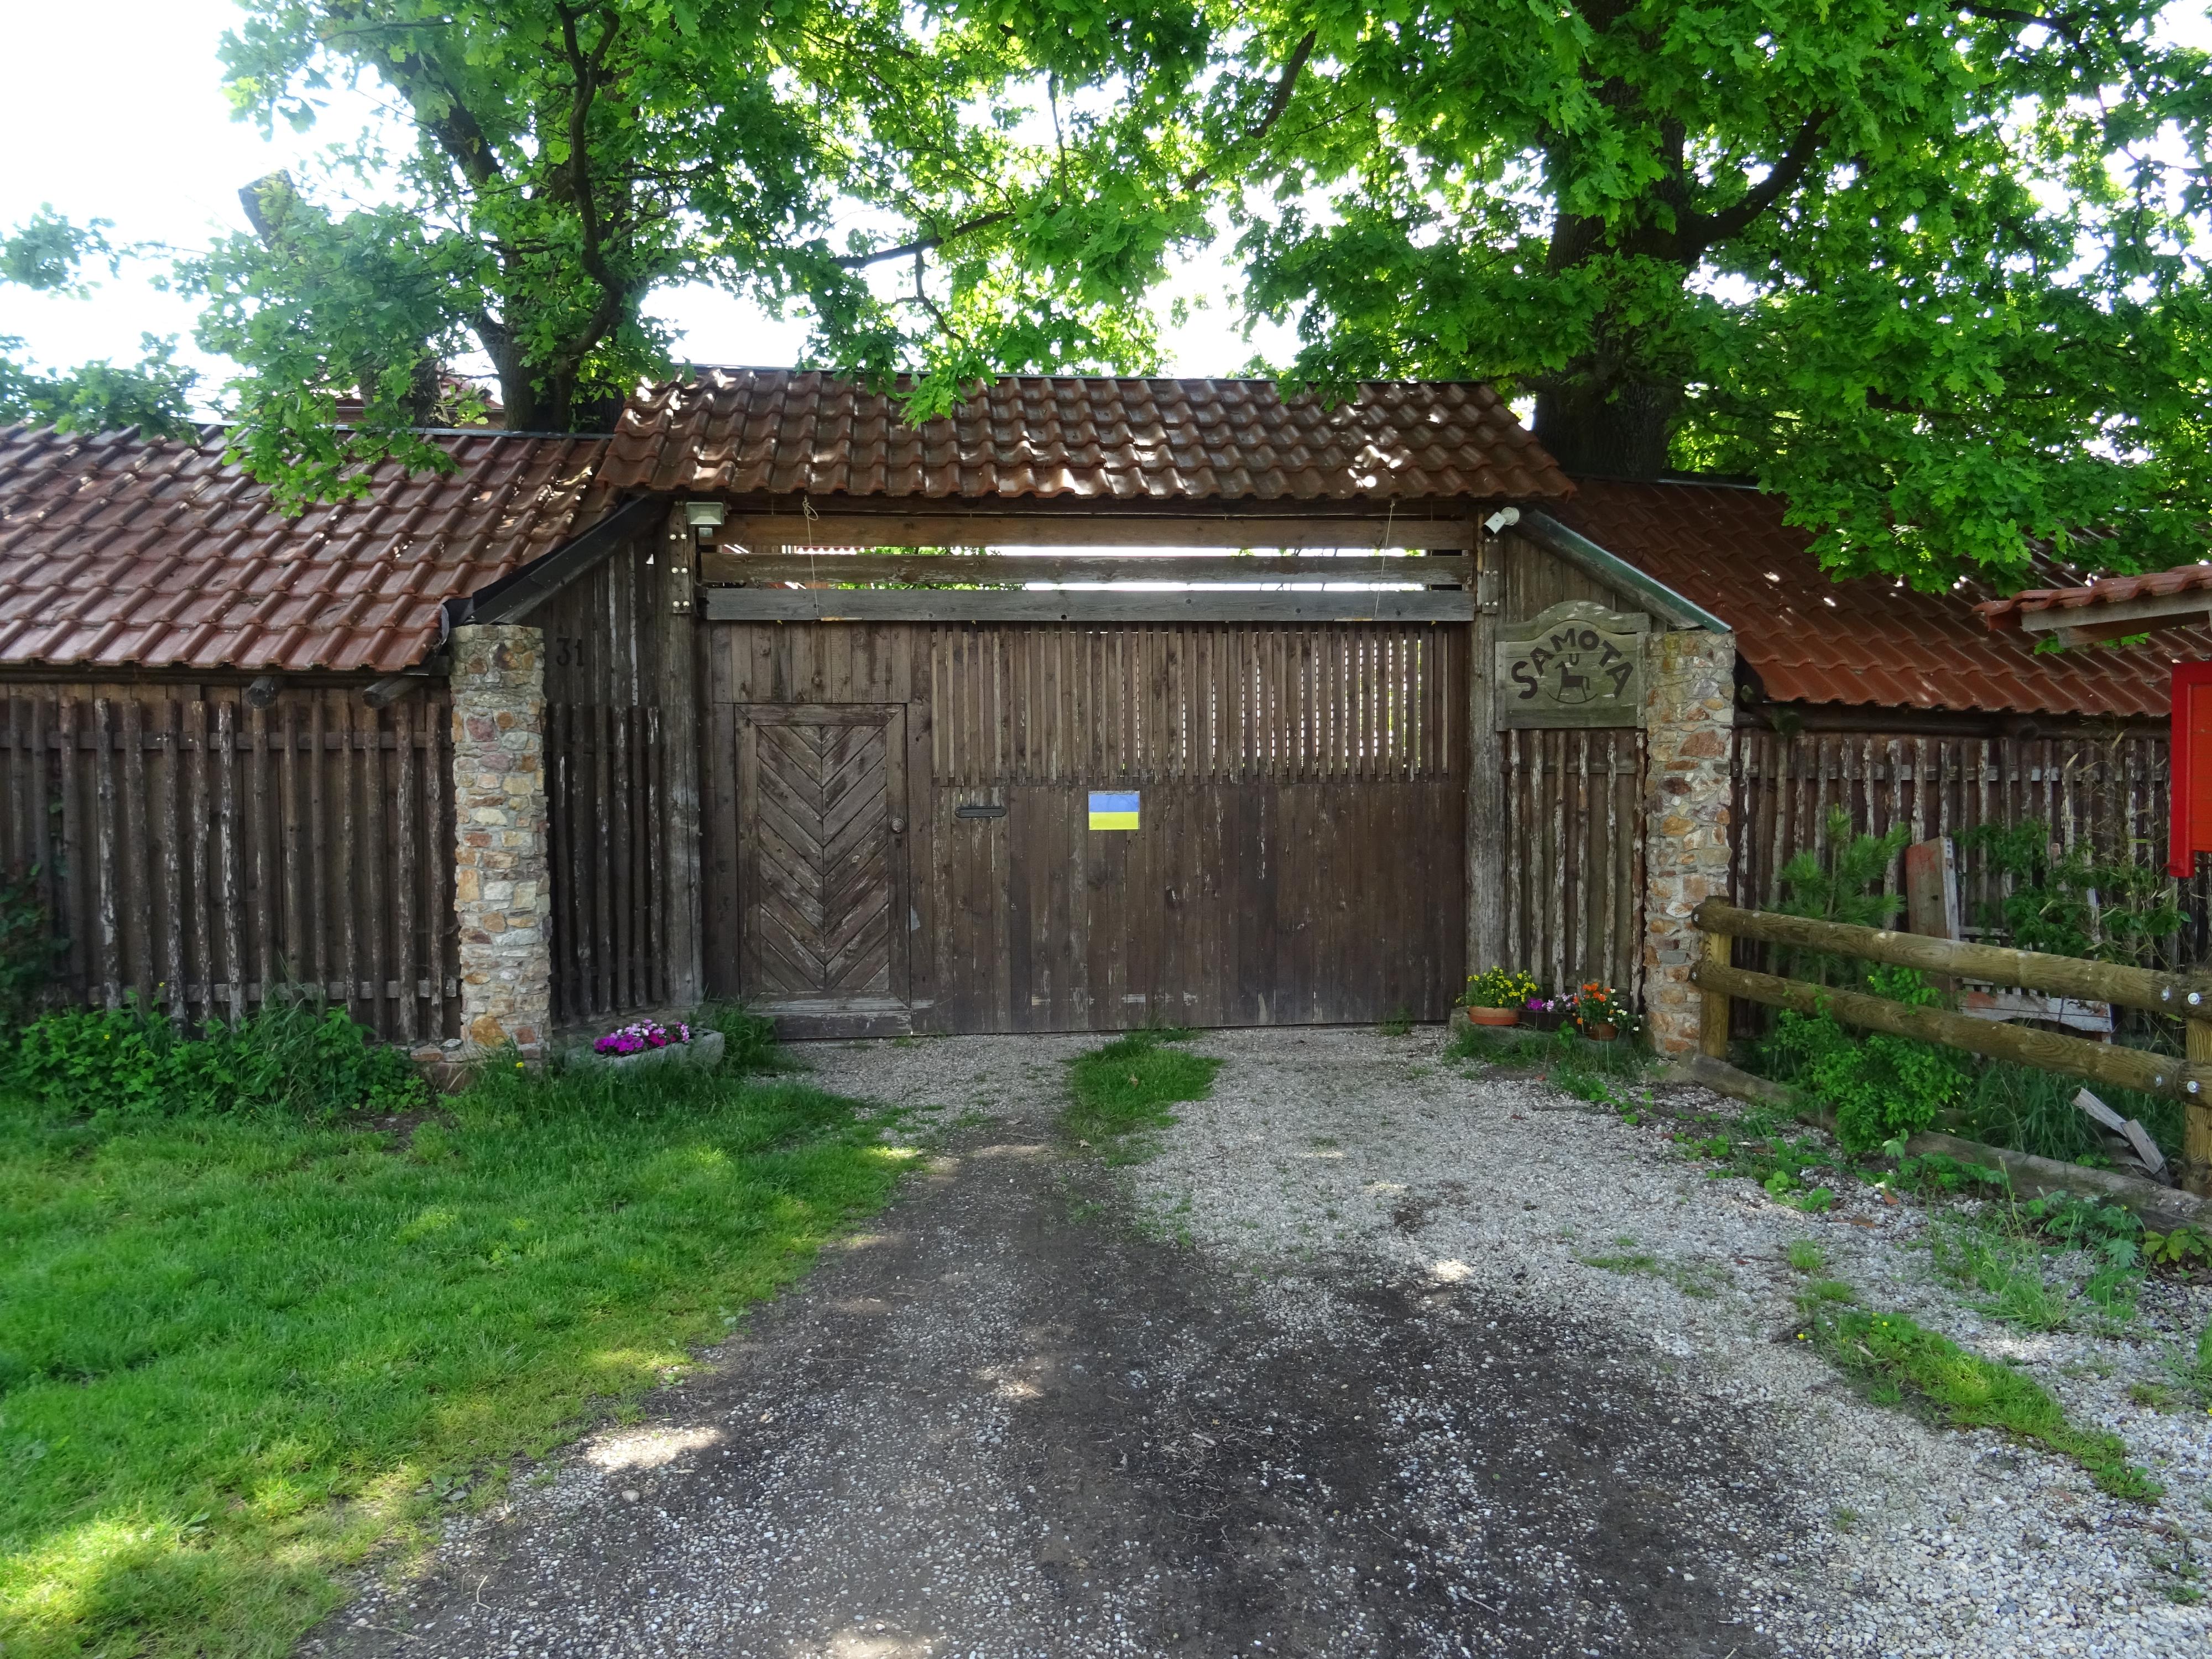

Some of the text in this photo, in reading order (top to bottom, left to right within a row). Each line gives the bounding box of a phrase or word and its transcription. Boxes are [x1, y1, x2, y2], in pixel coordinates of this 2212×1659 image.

[556, 638, 584, 666] 31
[1511, 628, 1634, 700] SAMOTA
[1569, 653, 1579, 666] U
